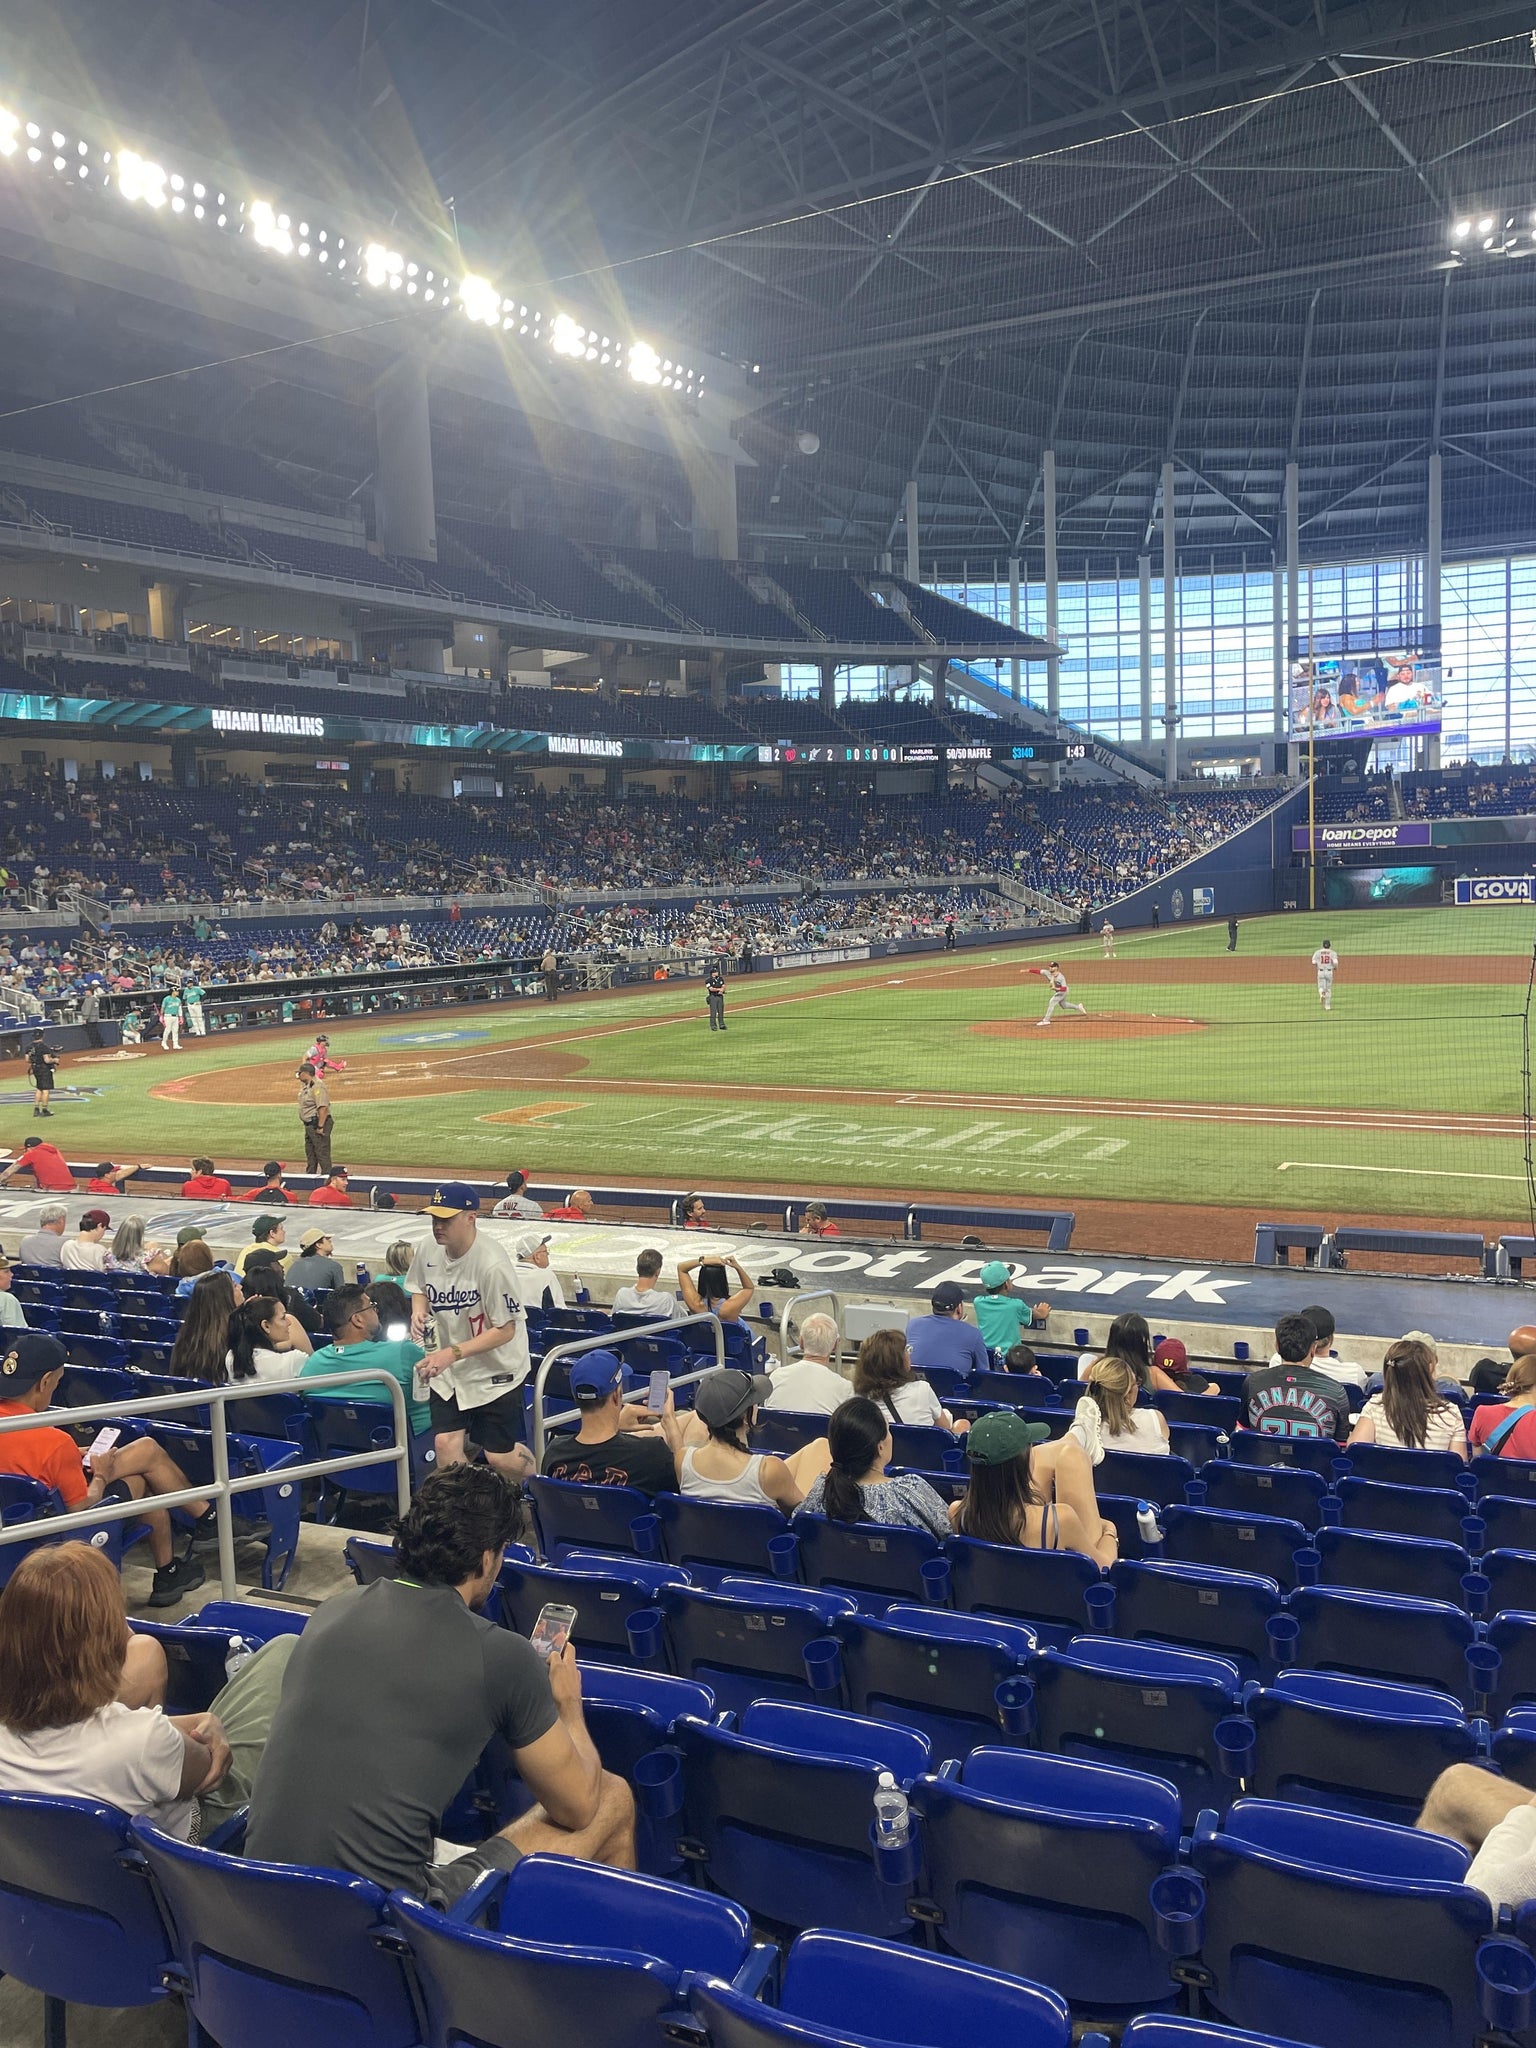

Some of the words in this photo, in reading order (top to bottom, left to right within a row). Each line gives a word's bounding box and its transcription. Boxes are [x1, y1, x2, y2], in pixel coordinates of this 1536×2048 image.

[212, 709, 259, 732] MIAMI
[261, 713, 324, 736] MARLINS
[549, 736, 579, 753] MIAMI
[580, 739, 623, 756] MARLINS
[947, 748, 967, 759] 50/50
[968, 748, 992, 759] RAFFLE
[1012, 747, 1034, 760] $3140
[1066, 745, 1086, 758] 1:43
[774, 749, 780, 761] 2
[827, 748, 833, 761] 2
[1322, 826, 1398, 841] loanDepot
[1474, 881, 1529, 898] GOYA
[1283, 901, 1297, 909] 344
[793, 1156, 898, 1169] MIAMI
[912, 1163, 1087, 1182] MARLINS
[503, 1202, 518, 1211] RUIZ
[913, 1259, 1252, 1305] park
[426, 1284, 481, 1315] Dodgers
[503, 1293, 520, 1313] LA
[1163, 1359, 1174, 1367] 07
